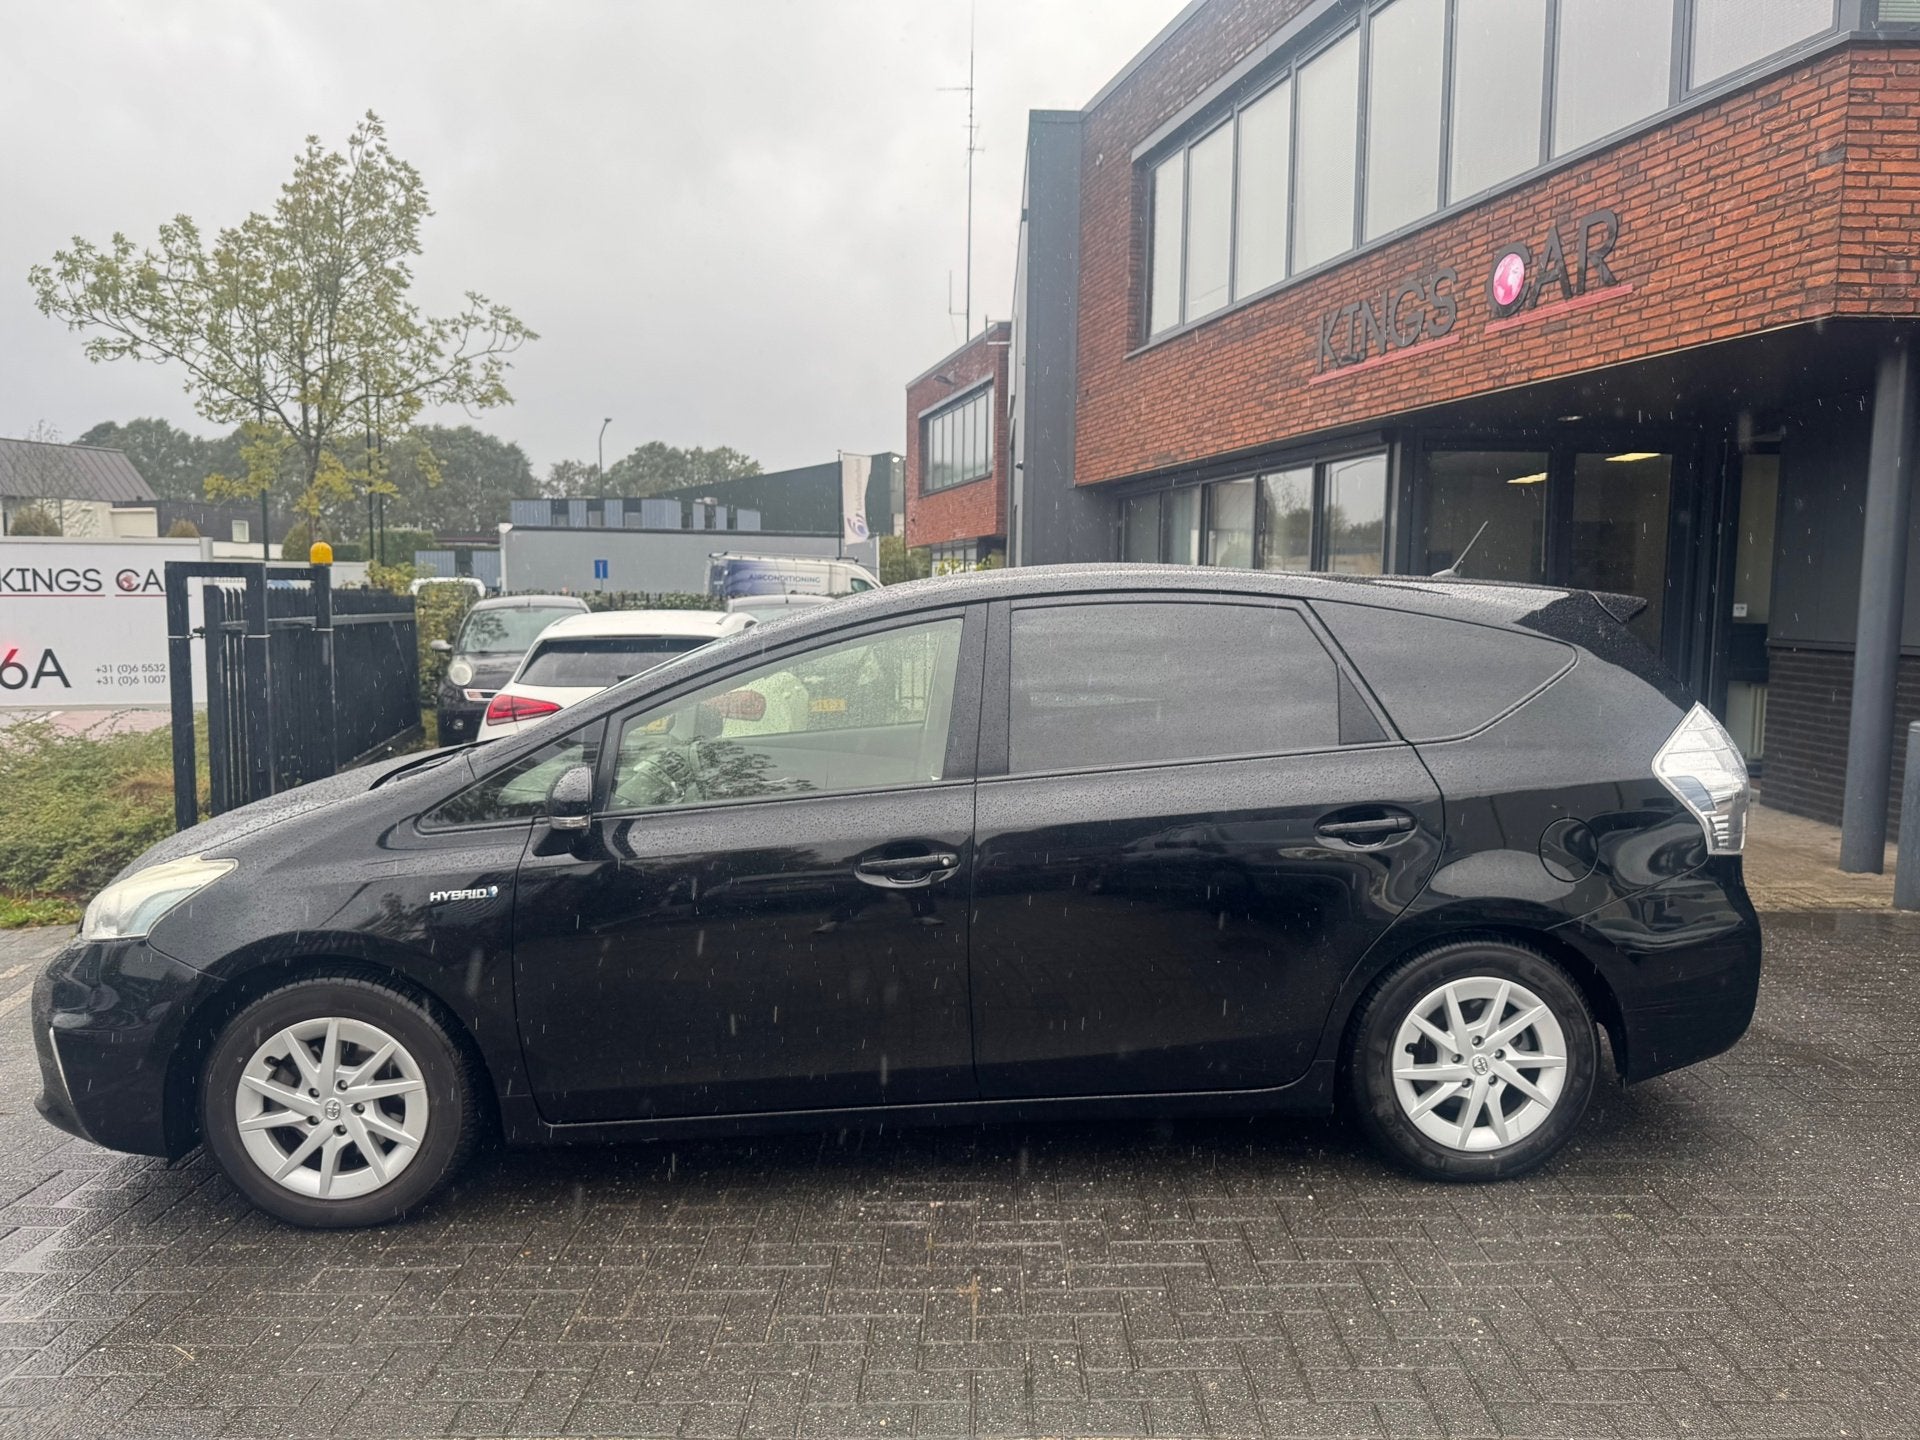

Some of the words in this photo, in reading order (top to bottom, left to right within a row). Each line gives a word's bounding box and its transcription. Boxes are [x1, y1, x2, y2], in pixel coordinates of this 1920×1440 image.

[1314, 267, 1458, 374] KINGS
[1486, 208, 1619, 318] CAR
[0, 568, 102, 592] KINGS
[116, 568, 164, 592] CA
[749, 573, 821, 584] AIRCONDITIONING
[96, 664, 113, 674] +31
[117, 664, 139, 675] (0)6
[141, 663, 166, 673] 5532
[96, 675, 113, 685] +31
[118, 675, 140, 686] (0)6
[143, 674, 166, 684] 1007
[429, 888, 487, 901] HYBRID
